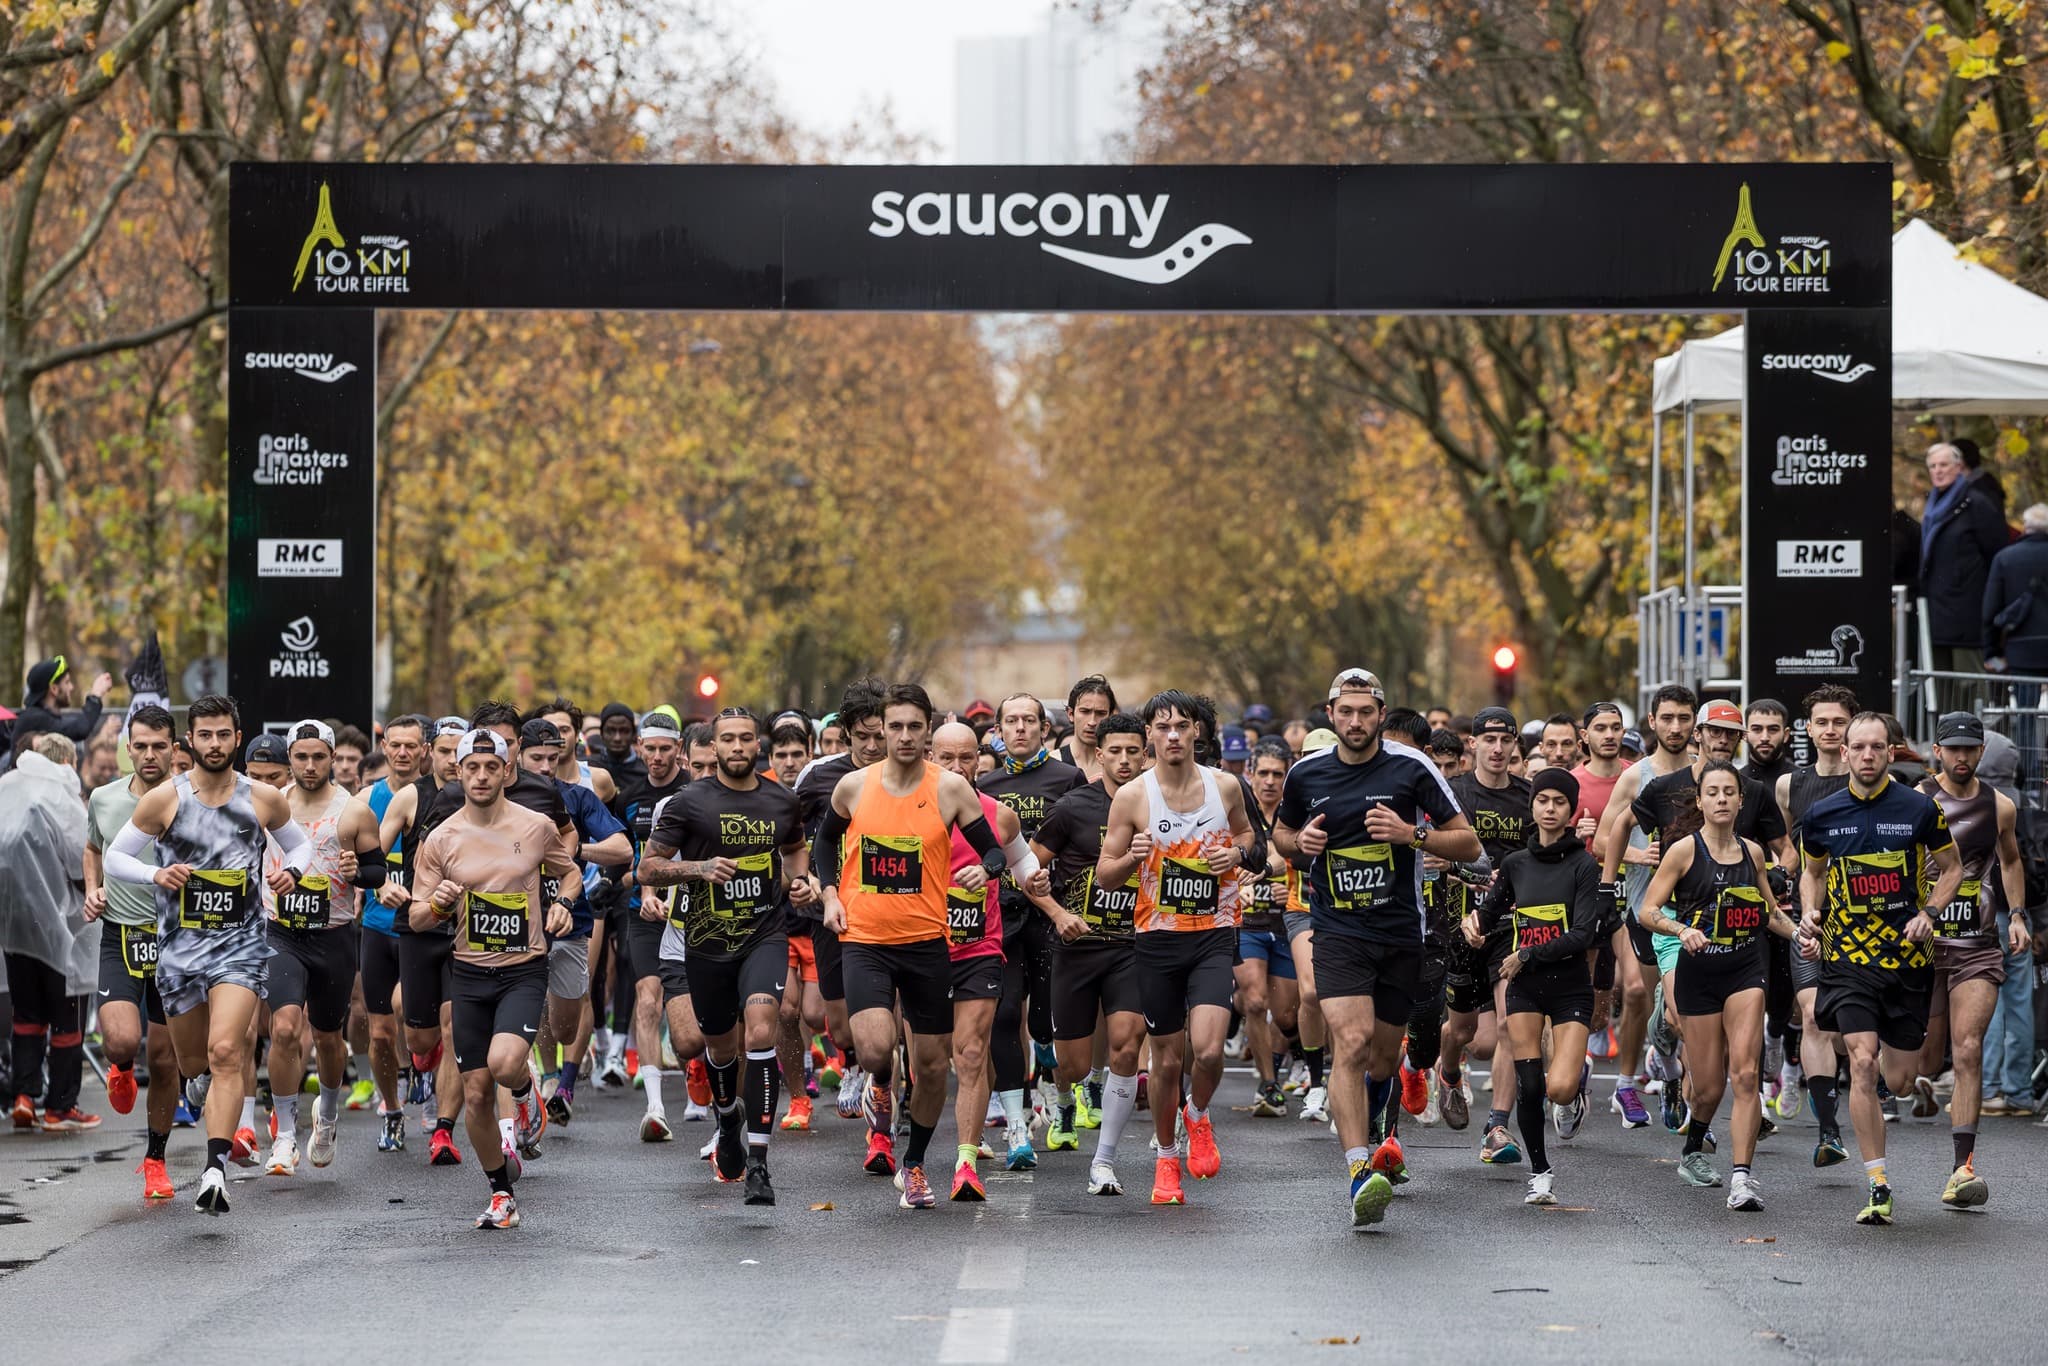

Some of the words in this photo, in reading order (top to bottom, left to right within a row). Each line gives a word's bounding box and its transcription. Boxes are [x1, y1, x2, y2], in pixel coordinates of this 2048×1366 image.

[868, 191, 1170, 249] saucony
[1780, 236, 1820, 245] saucony
[315, 249, 351, 275] 10
[356, 249, 410, 275] KM
[1735, 249, 1772, 275] 10
[1776, 249, 1830, 275] KM
[315, 277, 359, 293] TOUR
[364, 277, 410, 293] EIFFEL
[1735, 277, 1779, 293] TOUR
[1784, 277, 1830, 293] EIFFEL
[245, 352, 333, 372] saucony
[1762, 354, 1852, 372] saucony
[1777, 434, 1827, 458] Paris
[275, 544, 326, 562] RMC
[1794, 544, 1845, 563] RMC
[270, 659, 330, 677] PARIS
[1020, 810, 1044, 819] EIFFEL
[1496, 816, 1523, 830] KM
[720, 820, 742, 834] 10
[743, 820, 775, 834] KM
[721, 835, 746, 845] TOUR
[748, 835, 775, 845] EIFFEL
[870, 857, 908, 877] 1454
[724, 877, 761, 900] 9018
[1166, 878, 1213, 899] 10090
[1335, 866, 1386, 892] 15222
[1851, 872, 1900, 896] 10906
[193, 891, 233, 911] 7925
[1094, 888, 1136, 911] 21074
[1255, 884, 1275, 901] 22
[284, 893, 319, 913] 11415
[473, 913, 520, 935] 12289
[1726, 907, 1760, 928] 8925
